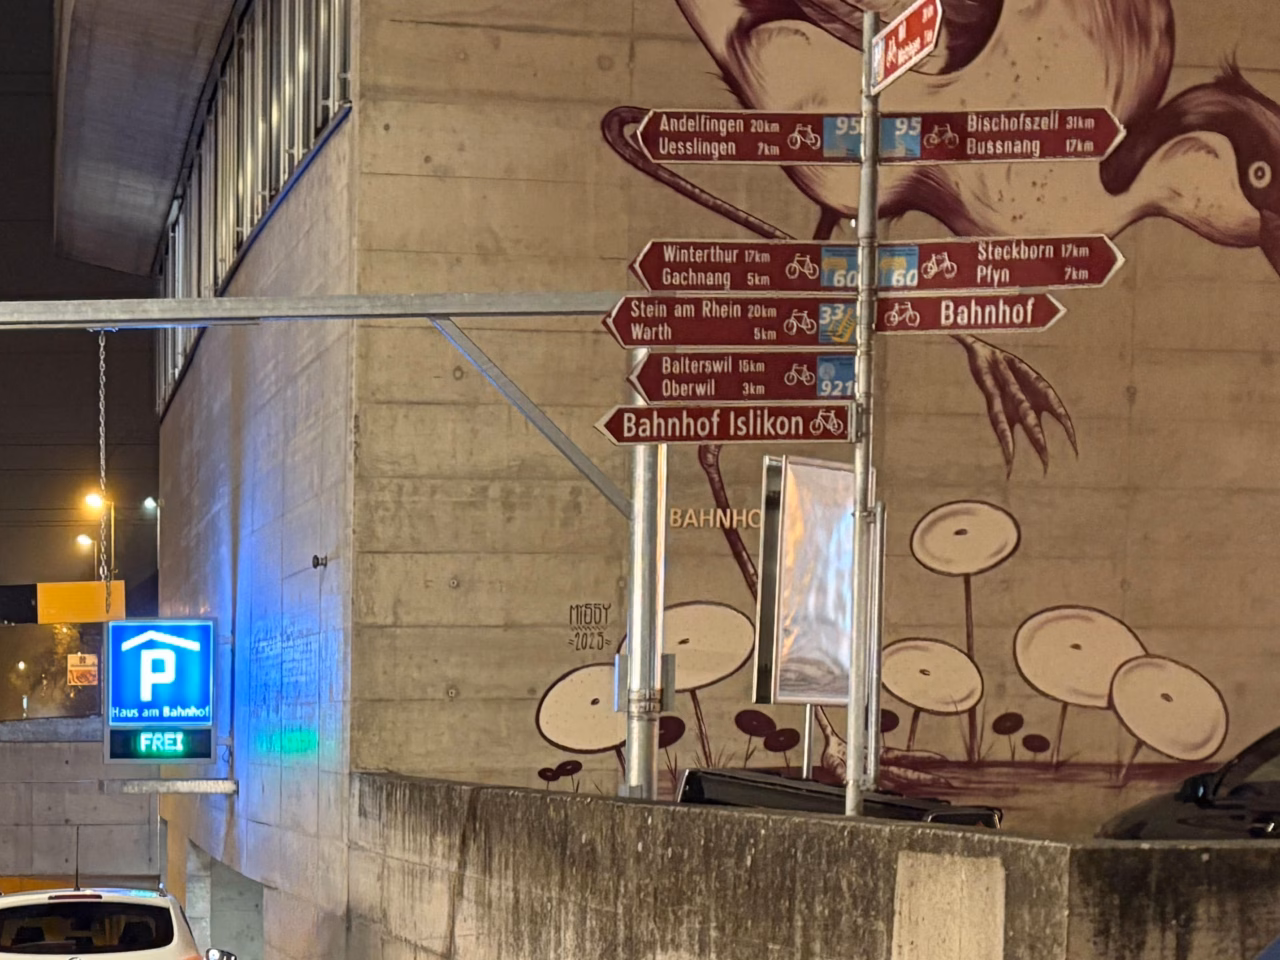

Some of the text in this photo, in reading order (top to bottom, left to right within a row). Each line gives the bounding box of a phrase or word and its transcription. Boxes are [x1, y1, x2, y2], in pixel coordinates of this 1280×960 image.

[659, 114, 780, 136] Andelfingen 20km
[836, 116, 862, 135] 95
[895, 117, 922, 136] 95
[967, 110, 1059, 132] Bischofszell
[659, 138, 780, 160] Uesslingen 7km
[966, 138, 1094, 156] Bussnang 17km
[663, 245, 770, 264] Winterthur 17km
[977, 241, 1089, 260] Steckborn 17km
[662, 268, 770, 290] Gachnang 5km
[833, 270, 859, 287] 60
[892, 269, 919, 287] 60
[976, 265, 1089, 287] Pfyn 7km
[630, 300, 777, 318] Stein am Rhein 20km
[818, 304, 845, 324] 33
[940, 297, 1036, 325] Bahnhof
[630, 323, 777, 340] Warth 5km
[662, 356, 765, 374] Balterswil 15km
[662, 379, 765, 397] Oberwil 3km
[820, 381, 854, 396] 921
[623, 410, 803, 437] Bahnhof Islikon
[140, 648, 176, 702] P
[112, 705, 210, 718] Haus am Bahnhof
[140, 731, 184, 752] FREI
